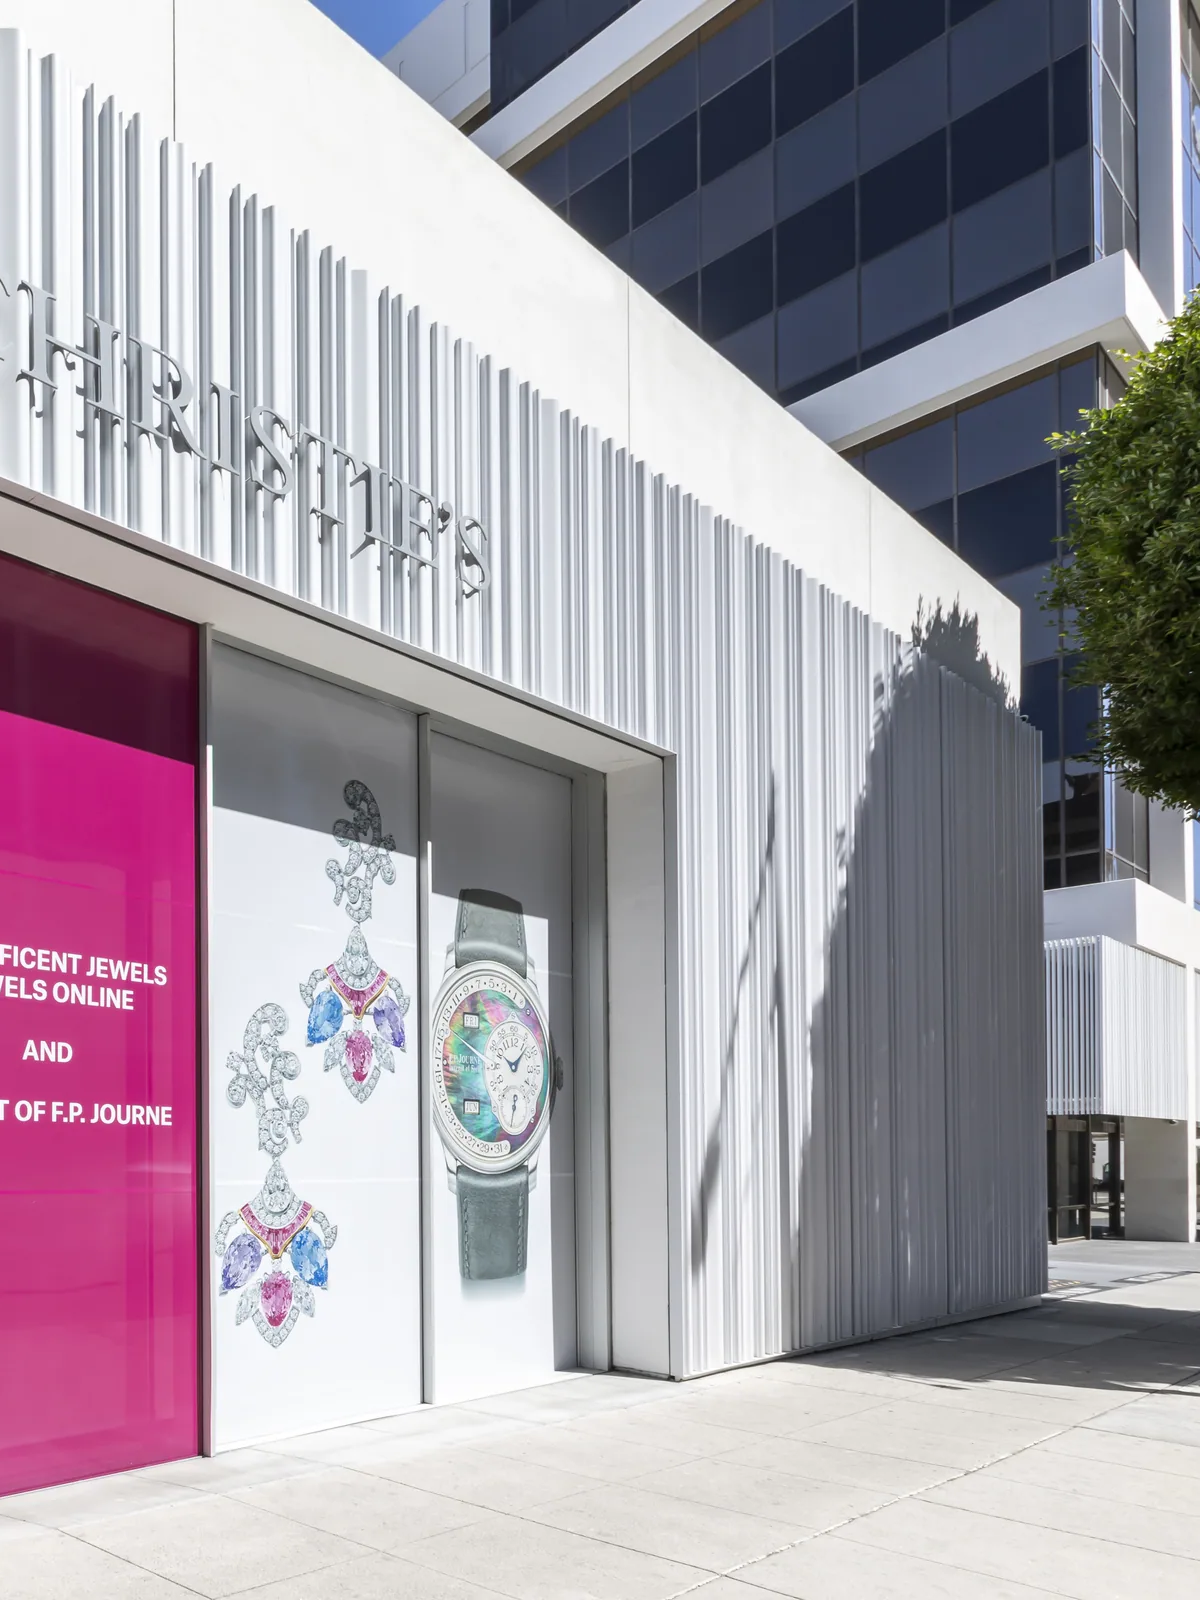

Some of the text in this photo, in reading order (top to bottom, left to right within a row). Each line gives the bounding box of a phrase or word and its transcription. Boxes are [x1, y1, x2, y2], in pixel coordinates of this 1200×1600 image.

[86, 956, 168, 986] JEWELS
[52, 981, 135, 1011] ONLINE
[22, 1039, 74, 1063] AND
[14, 1099, 47, 1122] OF
[51, 1101, 86, 1123] F.P.
[90, 1103, 173, 1126] JOURNE
